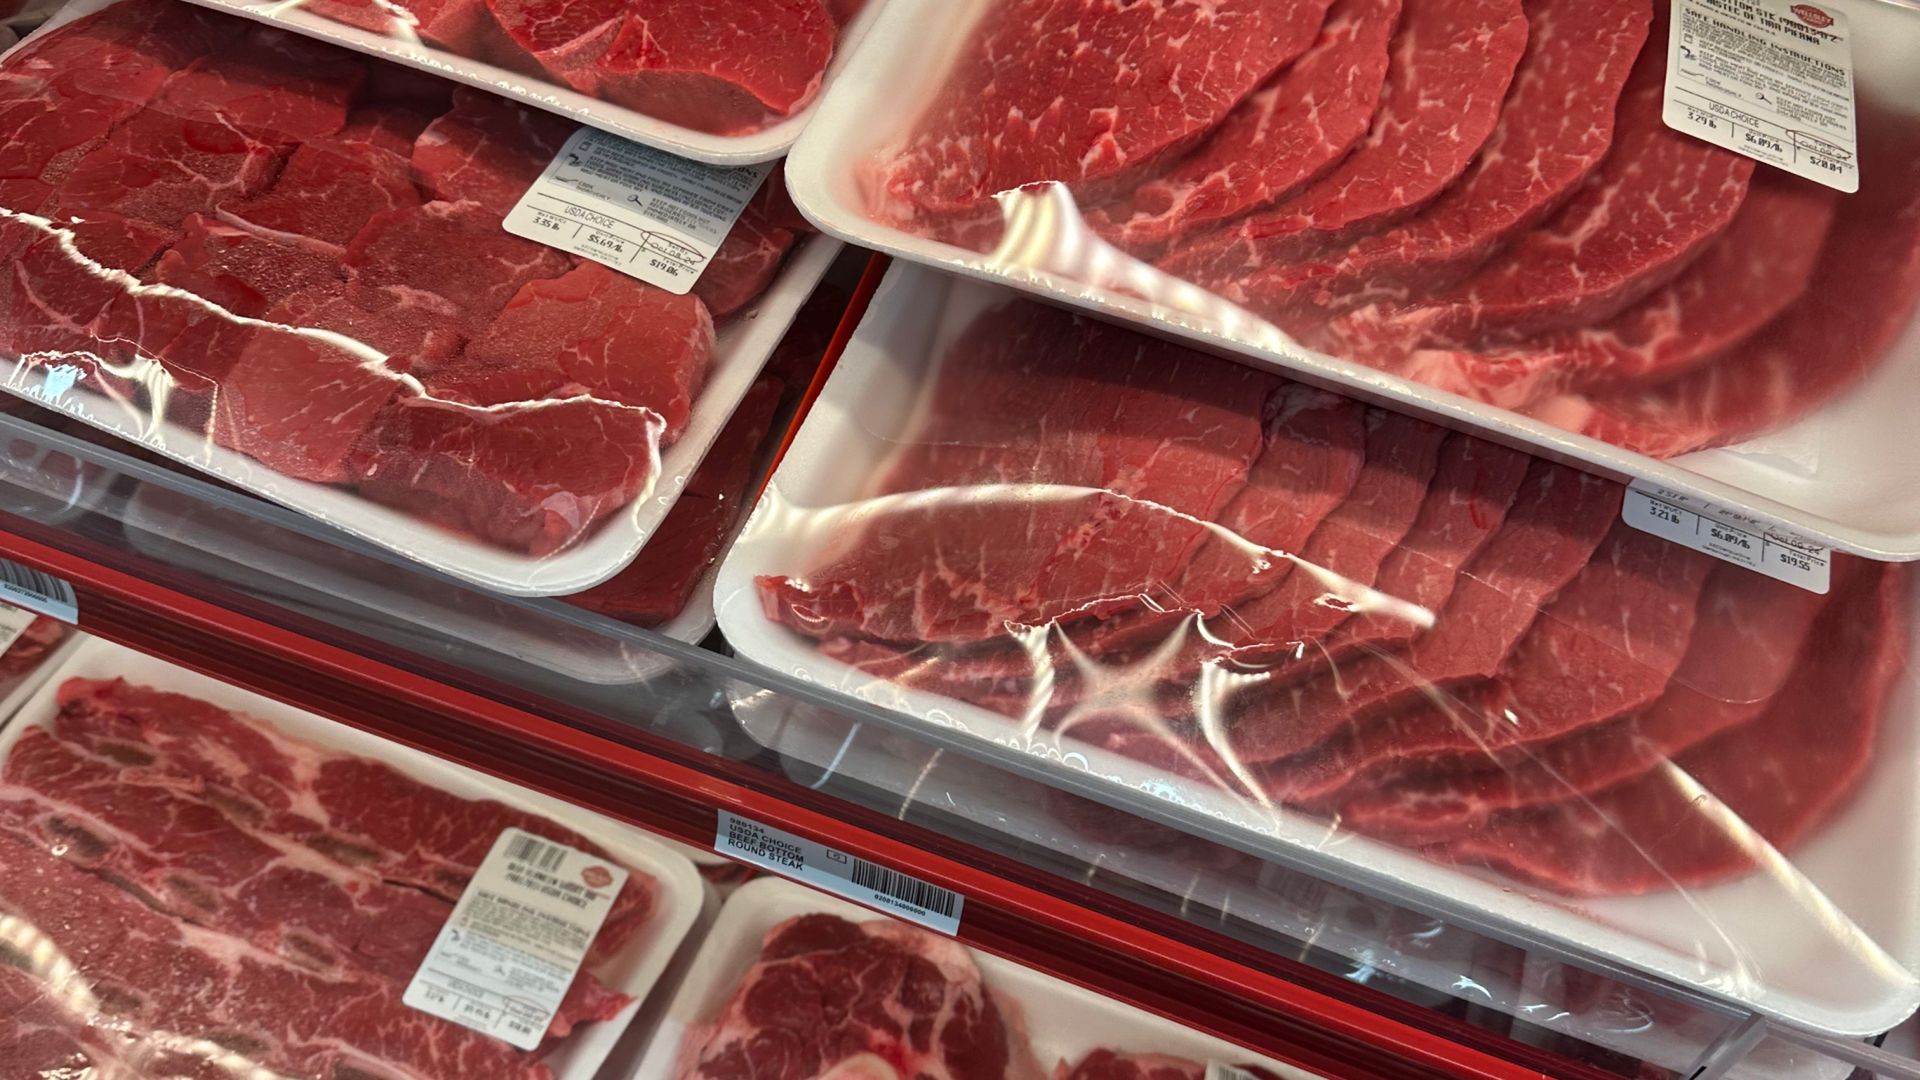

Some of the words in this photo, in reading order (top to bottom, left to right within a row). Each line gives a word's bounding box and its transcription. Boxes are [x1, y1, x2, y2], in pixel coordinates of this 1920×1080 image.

[1685, 8, 1707, 21] SAFE
[1771, 43, 1845, 76] INSTRUCTIONS
[1784, 26, 1820, 45] PIERNA
[1731, 110, 1759, 128] CHOICE
[1810, 155, 1843, 175] $20.04
[585, 211, 615, 229] CHOICE
[1780, 553, 1811, 571] $19.55
[728, 831, 757, 846] BEEF
[759, 841, 805, 863] BOTTOM
[729, 823, 759, 840] USDA
[761, 834, 802, 854] CHOICE
[728, 838, 766, 857] ROUND
[768, 851, 804, 872] STEAK
